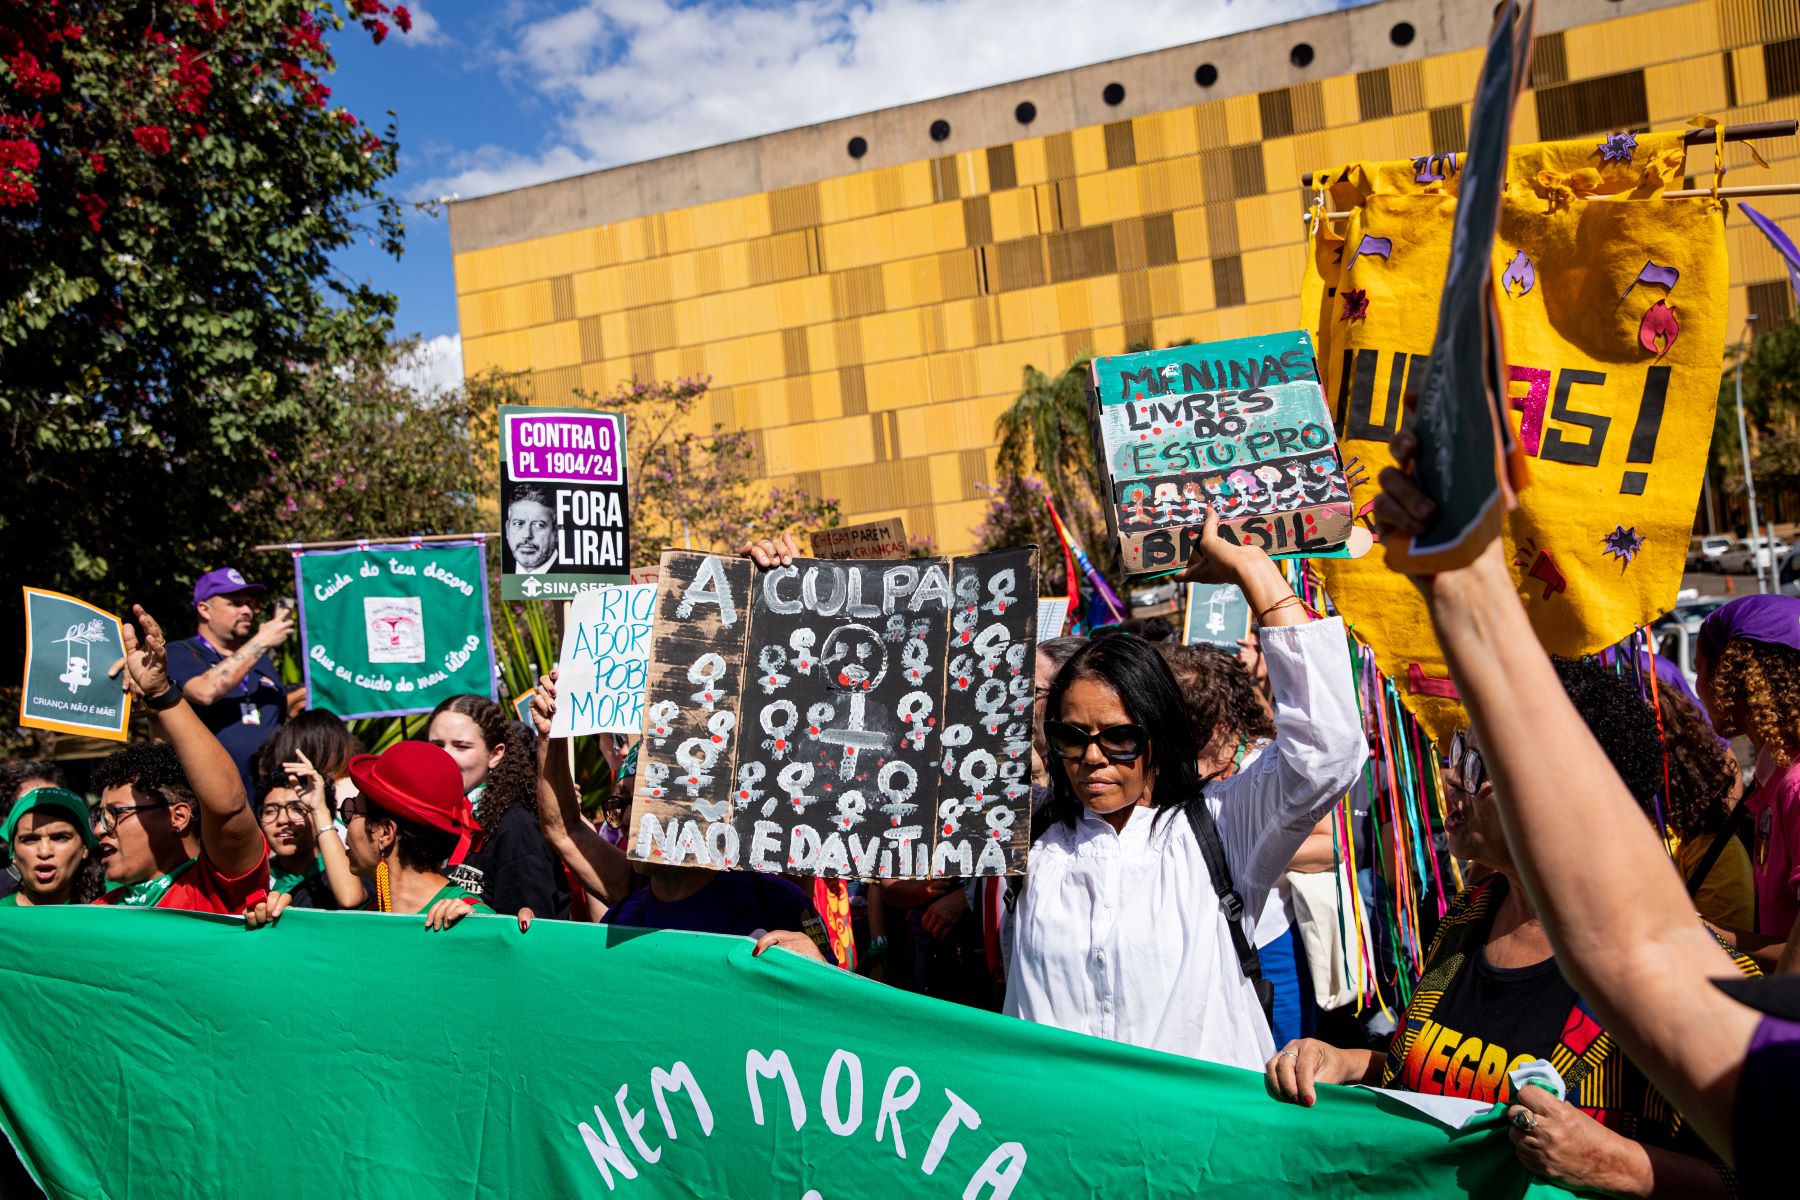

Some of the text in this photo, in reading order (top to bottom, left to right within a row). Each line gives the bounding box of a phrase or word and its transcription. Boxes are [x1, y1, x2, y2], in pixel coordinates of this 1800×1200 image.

[1120, 350, 1316, 399] MENINAS
[1125, 387, 1274, 431] LIVRES
[1194, 415, 1247, 438] DO
[520, 422, 611, 451] CONTRA O
[519, 451, 613, 476] PL 1904/24
[556, 489, 624, 528] FORA
[558, 529, 623, 567] LIRA!
[851, 527, 891, 543] PAREM
[854, 540, 906, 558] CRIANÇAS
[314, 557, 474, 602] Cuida do teu decoro
[675, 555, 956, 630] A CULPA
[310, 634, 481, 693] Que eu cuido do meu útero
[32, 696, 116, 717] CRIANÇA NÃO É MÃE!
[577, 1048, 1028, 1200] NEM MORTA
